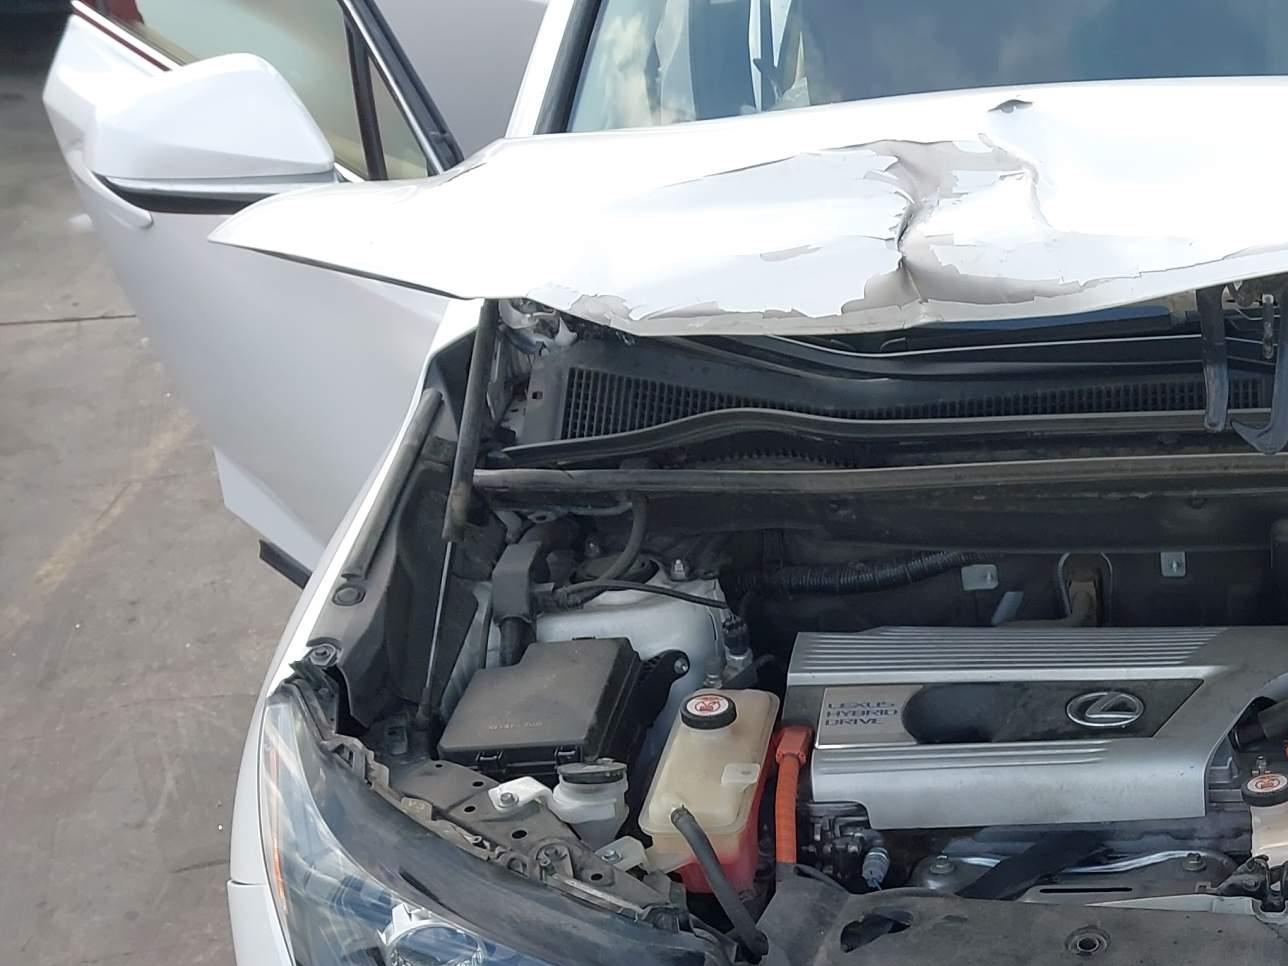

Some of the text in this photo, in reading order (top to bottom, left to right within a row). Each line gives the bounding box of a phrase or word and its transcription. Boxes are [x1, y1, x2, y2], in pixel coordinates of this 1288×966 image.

[827, 701, 895, 709] LEXUS
[826, 709, 898, 718] HYBRID
[825, 718, 884, 726] DRIVE
